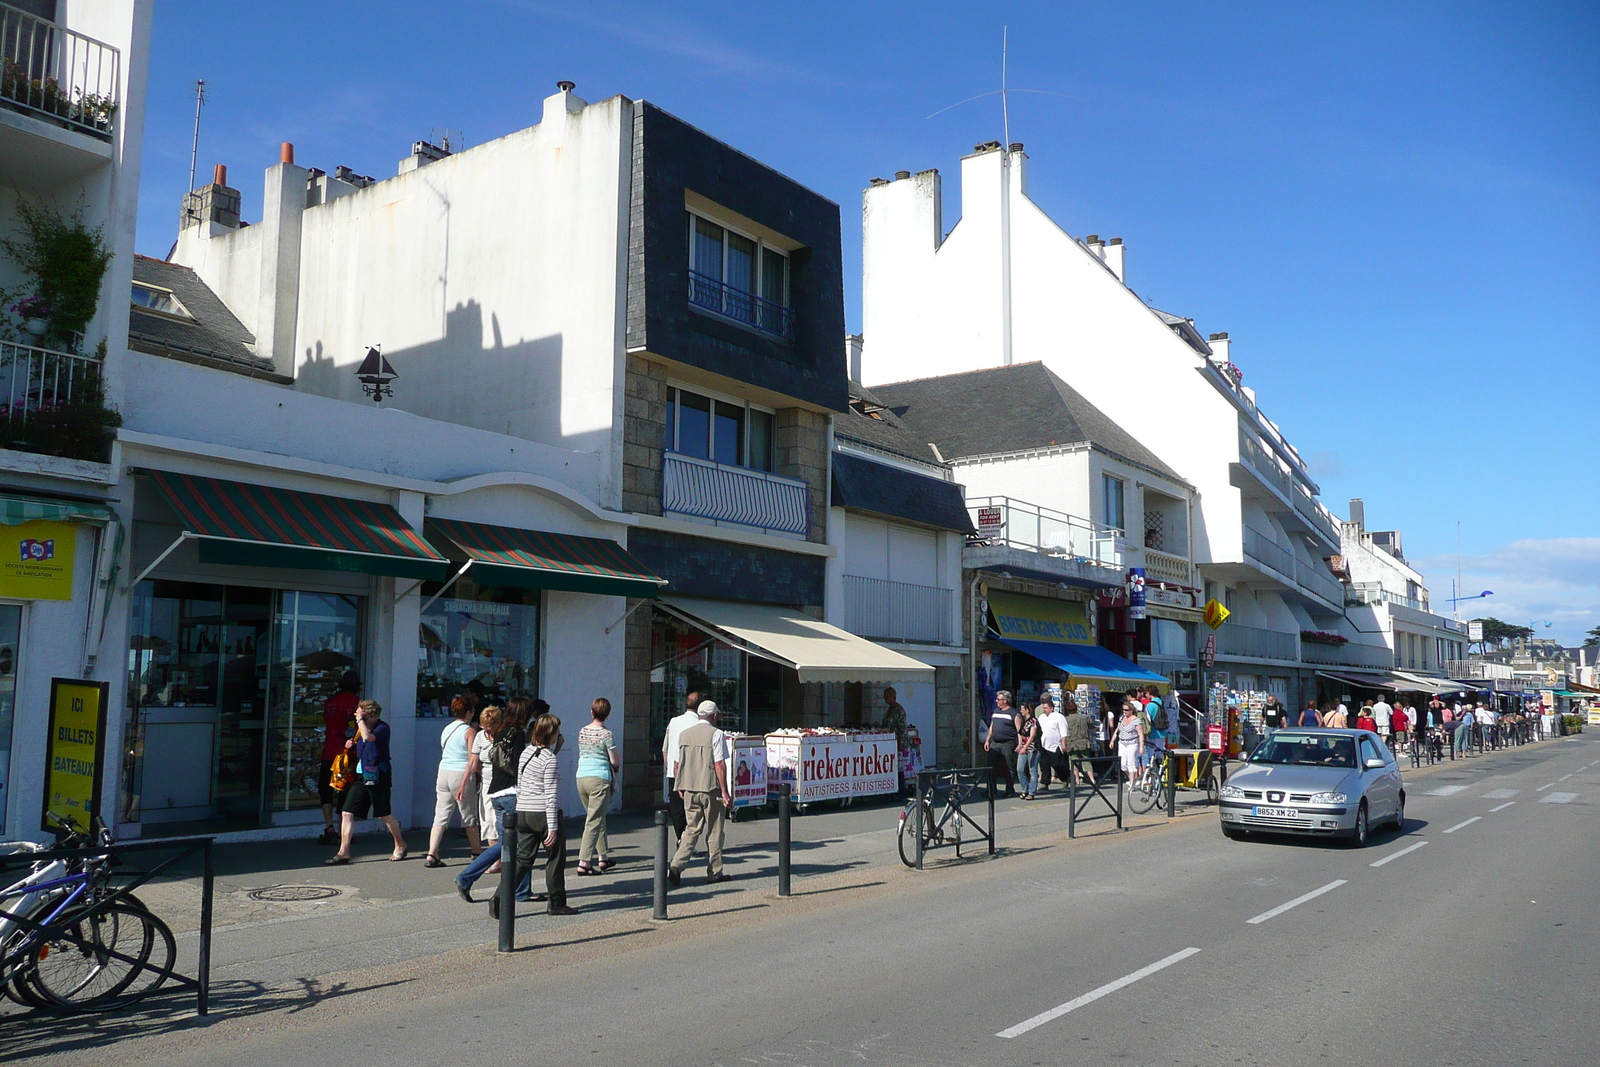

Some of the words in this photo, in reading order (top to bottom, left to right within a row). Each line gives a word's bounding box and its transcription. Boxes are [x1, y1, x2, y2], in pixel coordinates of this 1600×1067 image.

[1153, 590, 1171, 603] PRESSE
[997, 615, 1065, 638] BRETAGNE
[1063, 622, 1088, 640] SUD
[1211, 610, 1227, 628] PRESSE
[1206, 635, 1214, 667] TABAC
[71, 698, 83, 713] ICI
[58, 726, 94, 745] BILLETS
[54, 756, 94, 777] BATEAUX
[803, 747, 850, 782] rieker
[852, 744, 896, 777] rieker
[803, 782, 850, 798] ANTISTRESS
[852, 779, 895, 796] ANTISTRESS
[1257, 807, 1275, 816] 8852
[1276, 809, 1286, 817] XM
[1287, 809, 1296, 817] 22
